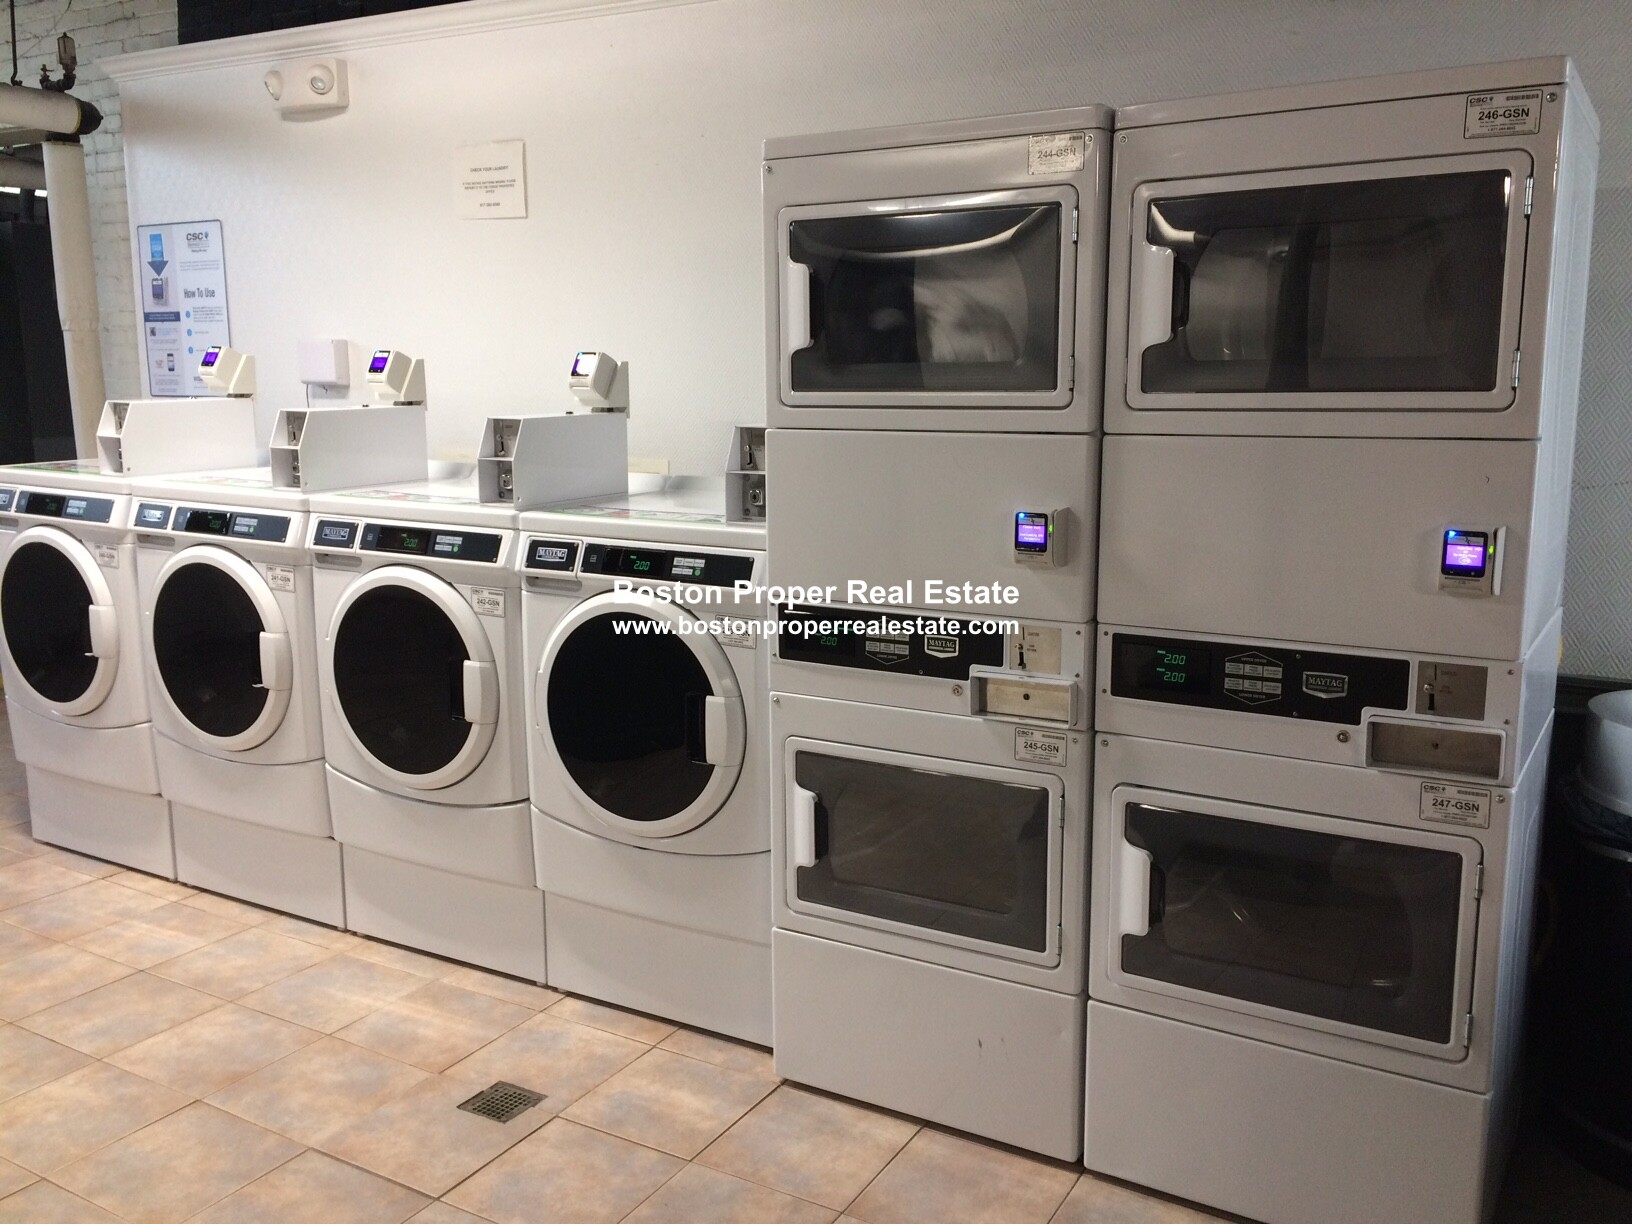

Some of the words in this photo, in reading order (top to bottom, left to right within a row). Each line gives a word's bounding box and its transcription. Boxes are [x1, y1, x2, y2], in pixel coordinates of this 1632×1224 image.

[1478, 108, 1530, 120] 246-GSN
[1038, 148, 1076, 159] 244-GSN
[186, 232, 203, 241] CSC
[184, 288, 196, 298] How
[197, 287, 203, 298] To
[204, 287, 215, 298] Use
[538, 549, 565, 557] MAYTAG
[634, 560, 650, 570] 2.00
[477, 598, 500, 606] 242-GSN
[820, 636, 837, 646] 2.00
[928, 639, 955, 648] MAYTAG
[1164, 654, 1186, 665] 2.00
[1164, 672, 1185, 682] 2.00
[1308, 676, 1343, 687] MAYTAG
[1024, 741, 1059, 753] 245-GSN
[1432, 798, 1480, 812] 247-GSN
